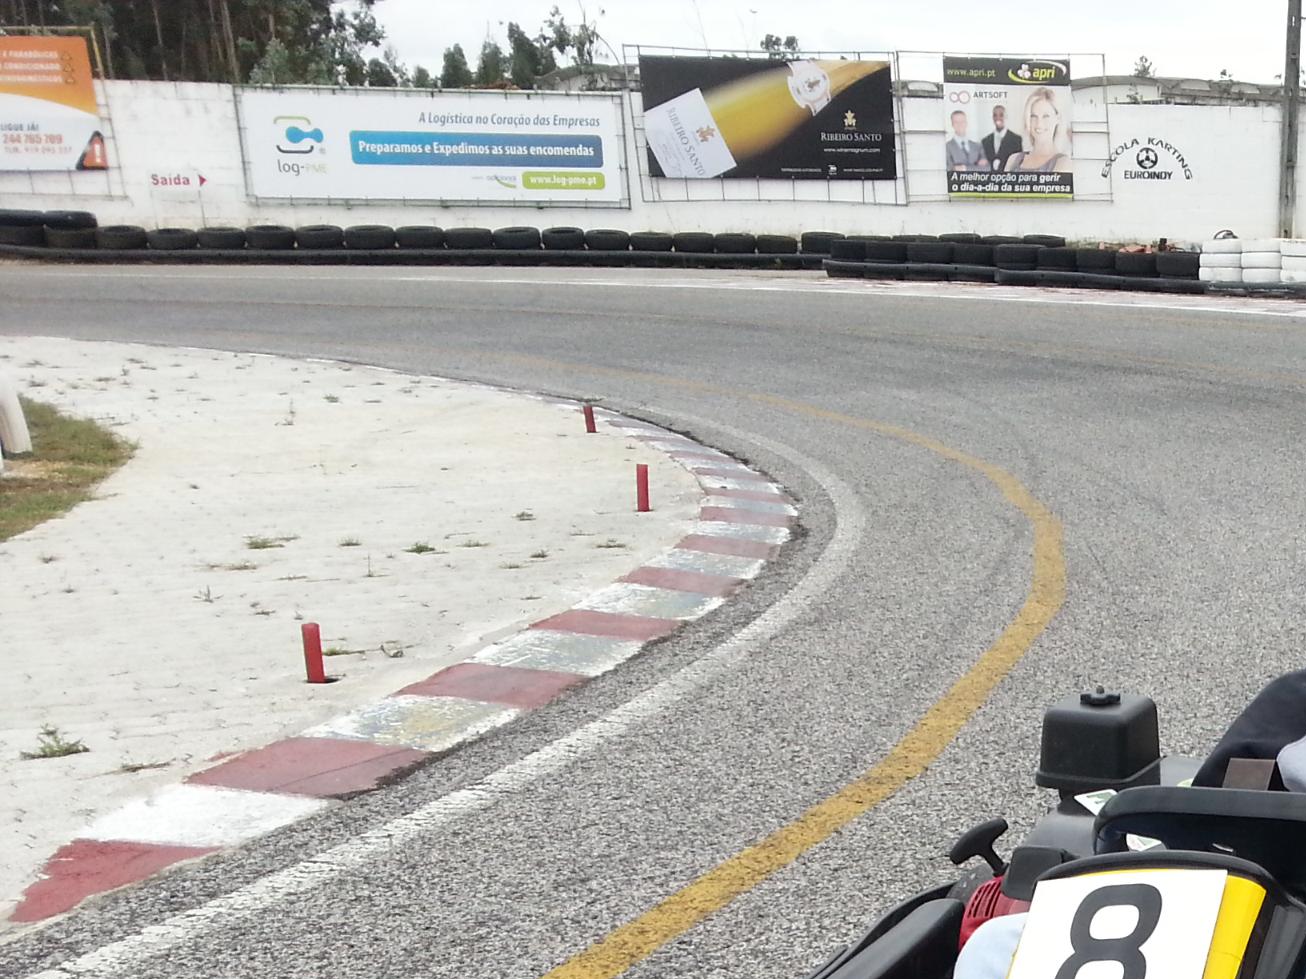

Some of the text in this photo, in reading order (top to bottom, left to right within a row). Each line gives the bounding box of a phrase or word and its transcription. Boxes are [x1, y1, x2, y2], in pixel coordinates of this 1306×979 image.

[946, 68, 997, 78] www.apri.pt
[1032, 66, 1056, 80] apri
[973, 91, 1008, 99] ARTSOFT
[418, 112, 600, 129] A Logística no Coração das Empresas
[666, 106, 690, 146] RIBEIRO
[685, 145, 706, 176] SANTO
[820, 131, 882, 142] RIBEIRO SANTO
[358, 140, 594, 157] Preparamos e Expedimos as suas encomendas
[1101, 137, 1193, 180] ESCOLA KARTING
[951, 172, 1061, 183] A melhor opção para gerir
[1124, 170, 1173, 180] EUROINDY
[960, 183, 999, 192] dia-a-dia
[1001, 183, 1012, 192] da
[1014, 184, 1030, 192] sua
[1033, 184, 1071, 194] empresa
